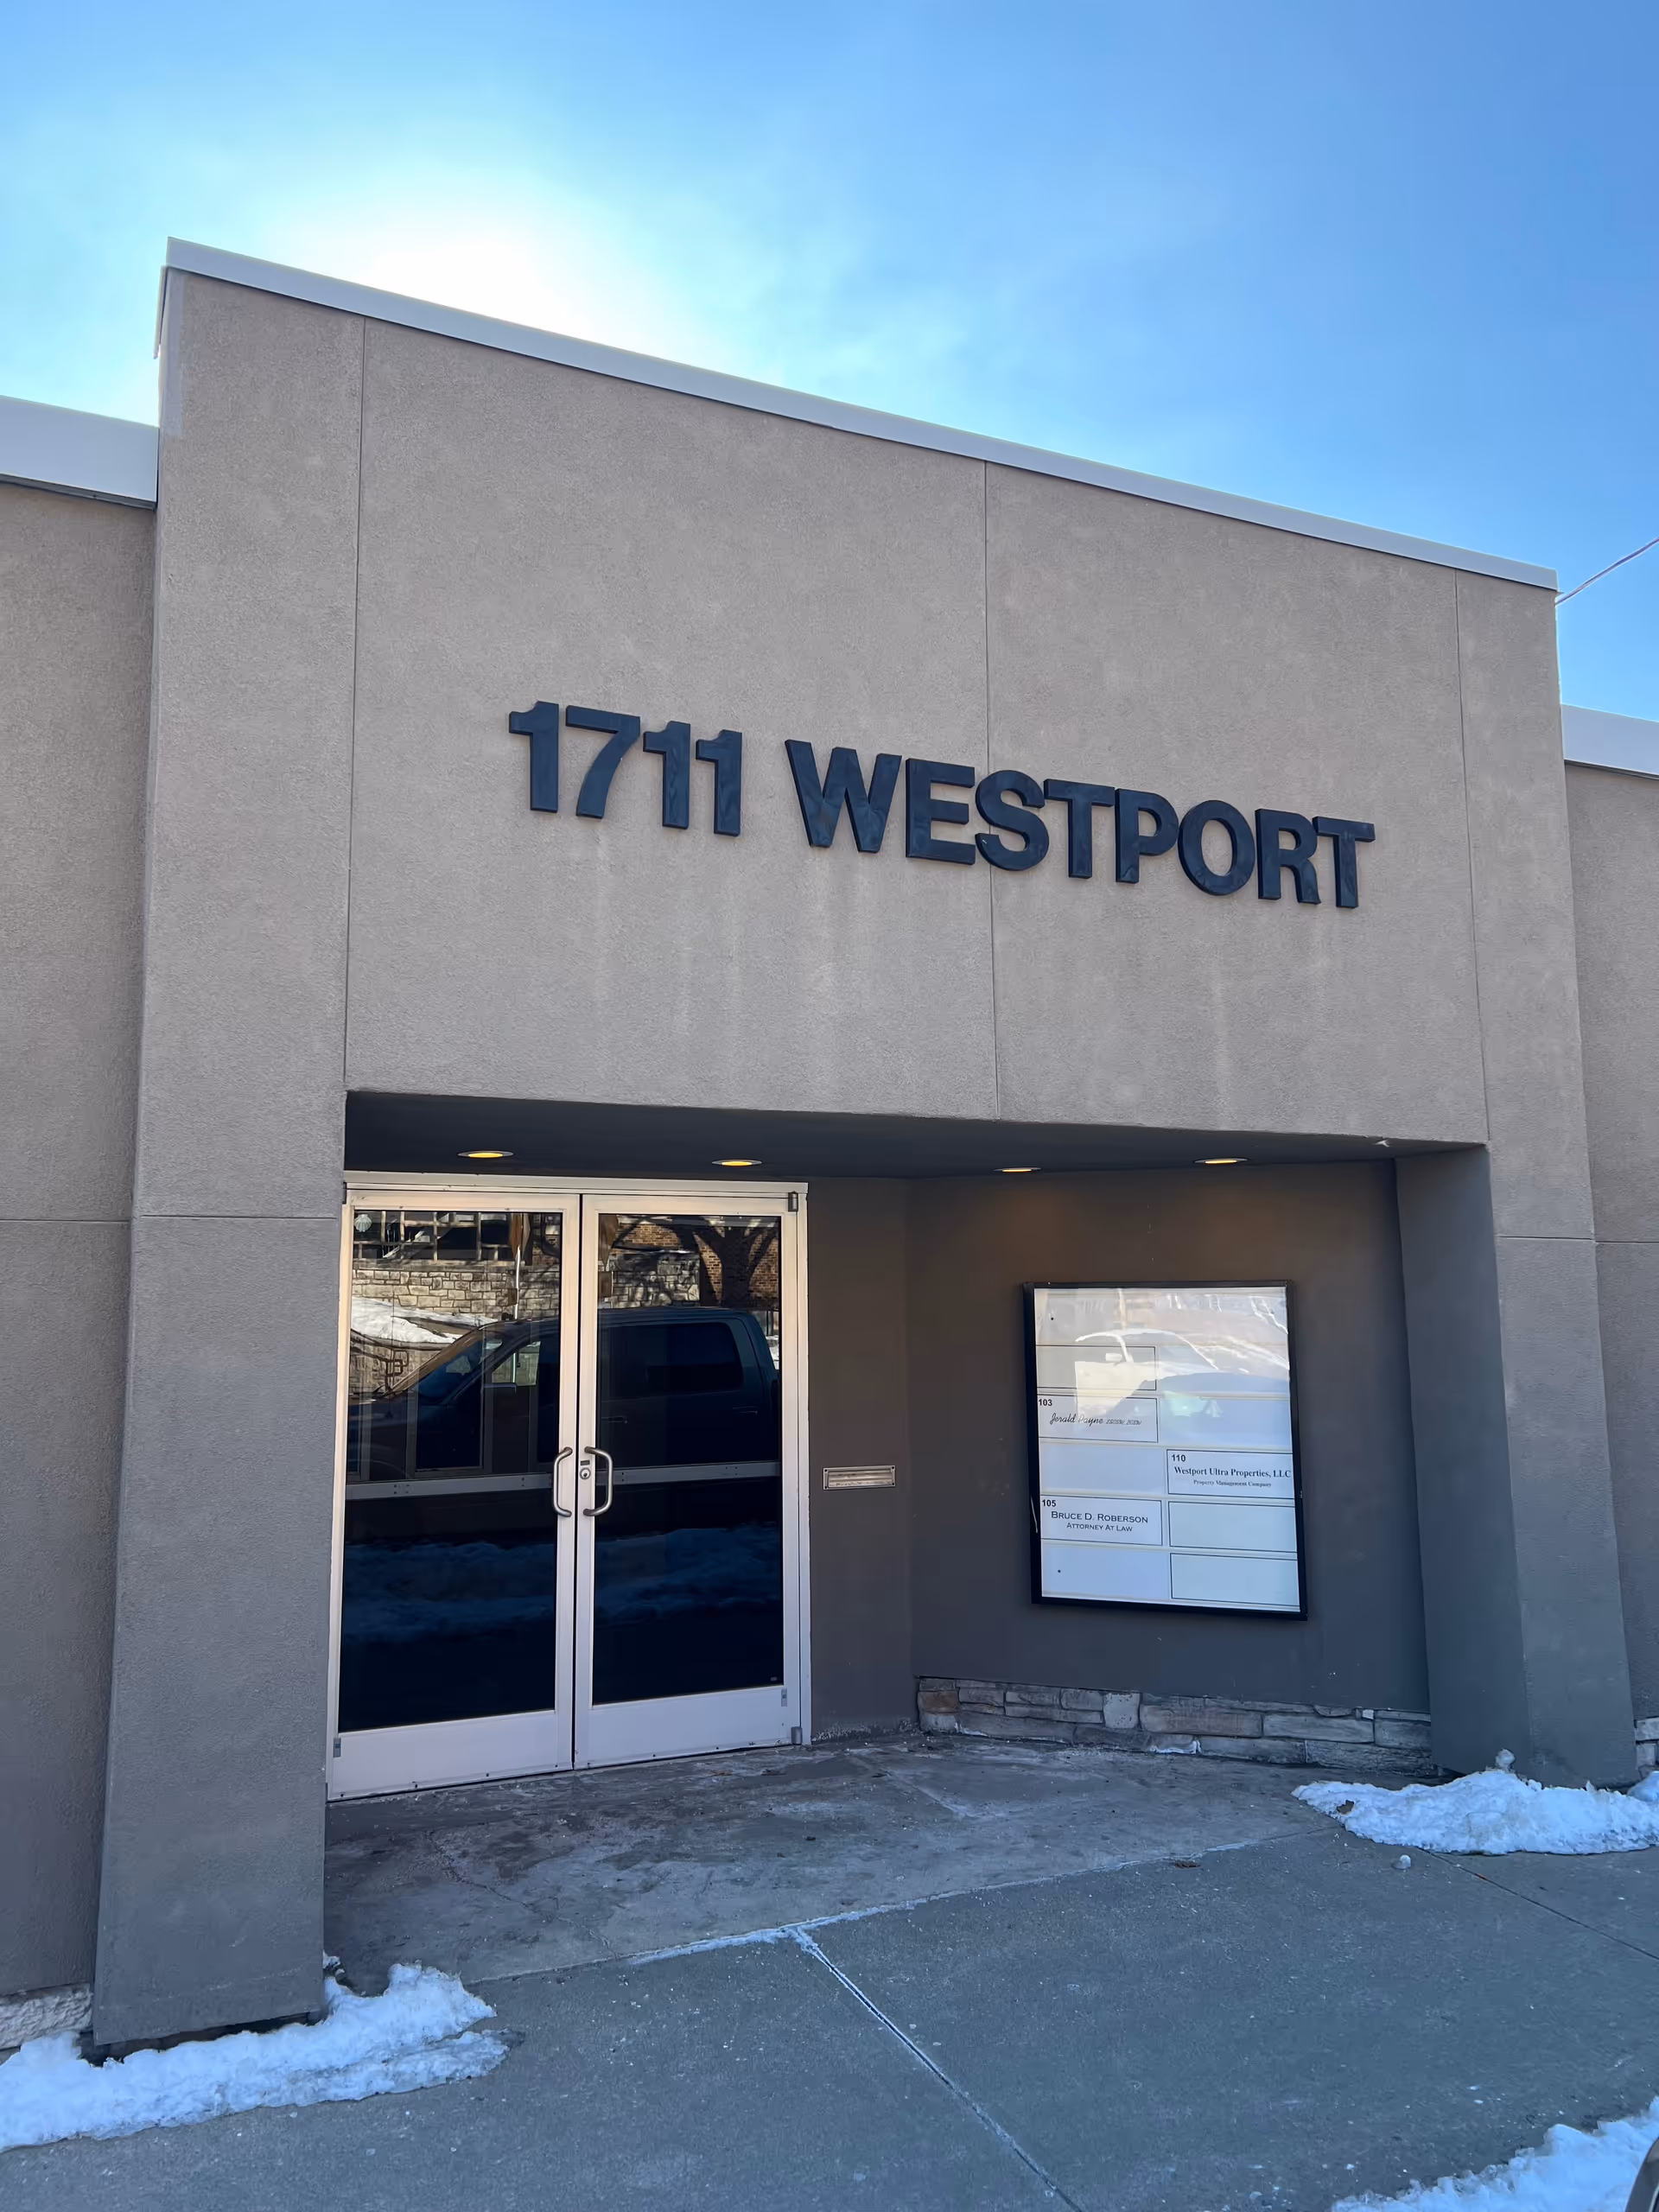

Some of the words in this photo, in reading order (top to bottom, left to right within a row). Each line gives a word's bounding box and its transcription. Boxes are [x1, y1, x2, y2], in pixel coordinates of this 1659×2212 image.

[509, 700, 743, 837] 1711
[784, 738, 1376, 909] WESTPORT
[1039, 1398, 1052, 1407] 103
[1049, 1412, 1077, 1425] Jerald
[1077, 1413, 1104, 1427] Payne
[1174, 1466, 1207, 1476] Westport
[1230, 1468, 1271, 1478] Properties,
[1273, 1470, 1292, 1478] LLC
[1084, 1512, 1095, 1521] D.
